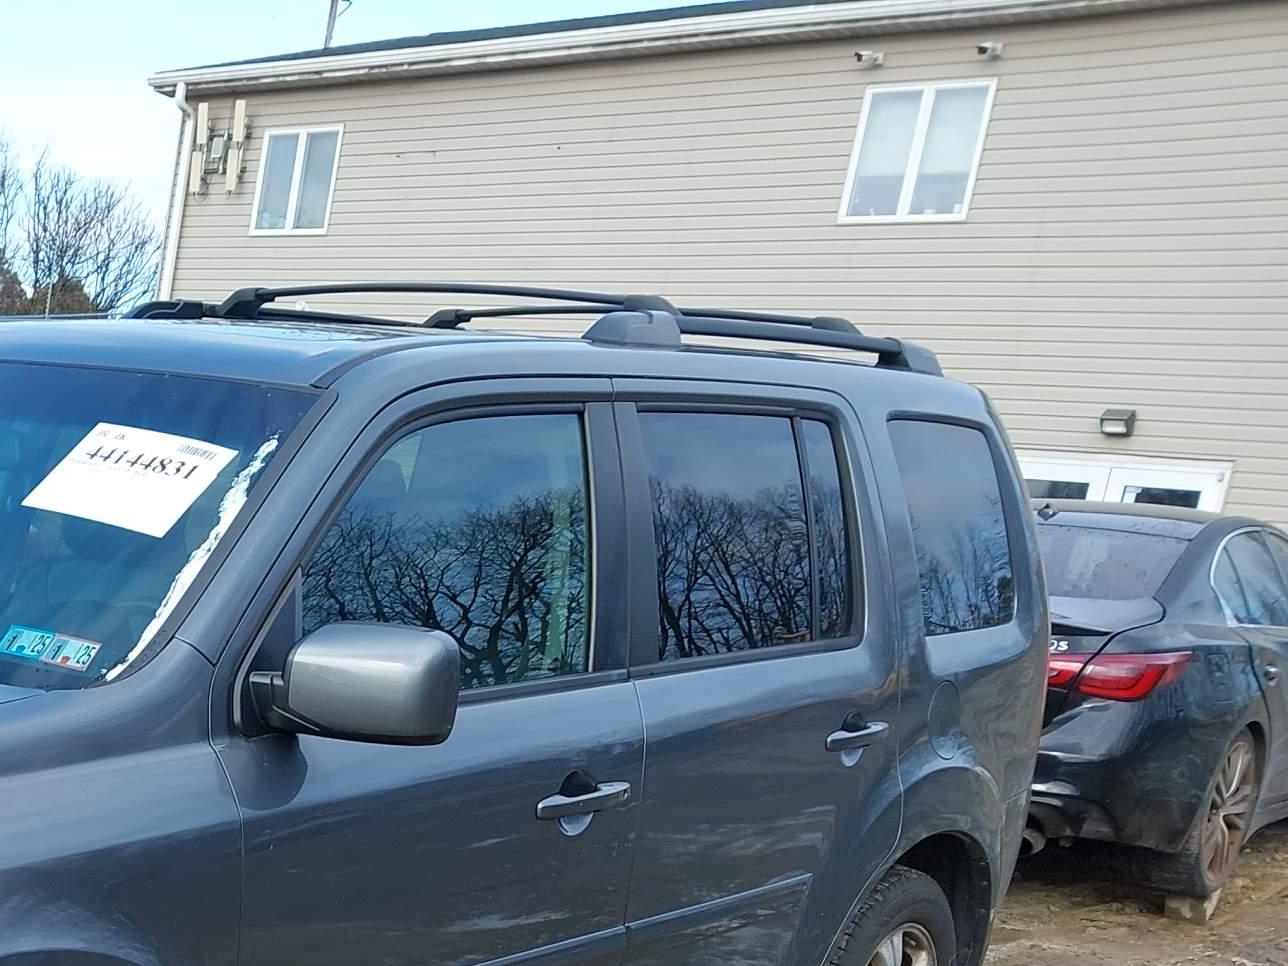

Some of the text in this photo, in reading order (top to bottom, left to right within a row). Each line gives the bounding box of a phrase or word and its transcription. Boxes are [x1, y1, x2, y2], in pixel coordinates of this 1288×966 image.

[86, 445, 200, 479] 44144831
[31, 635, 51, 654] 25
[76, 645, 97, 665] 25
